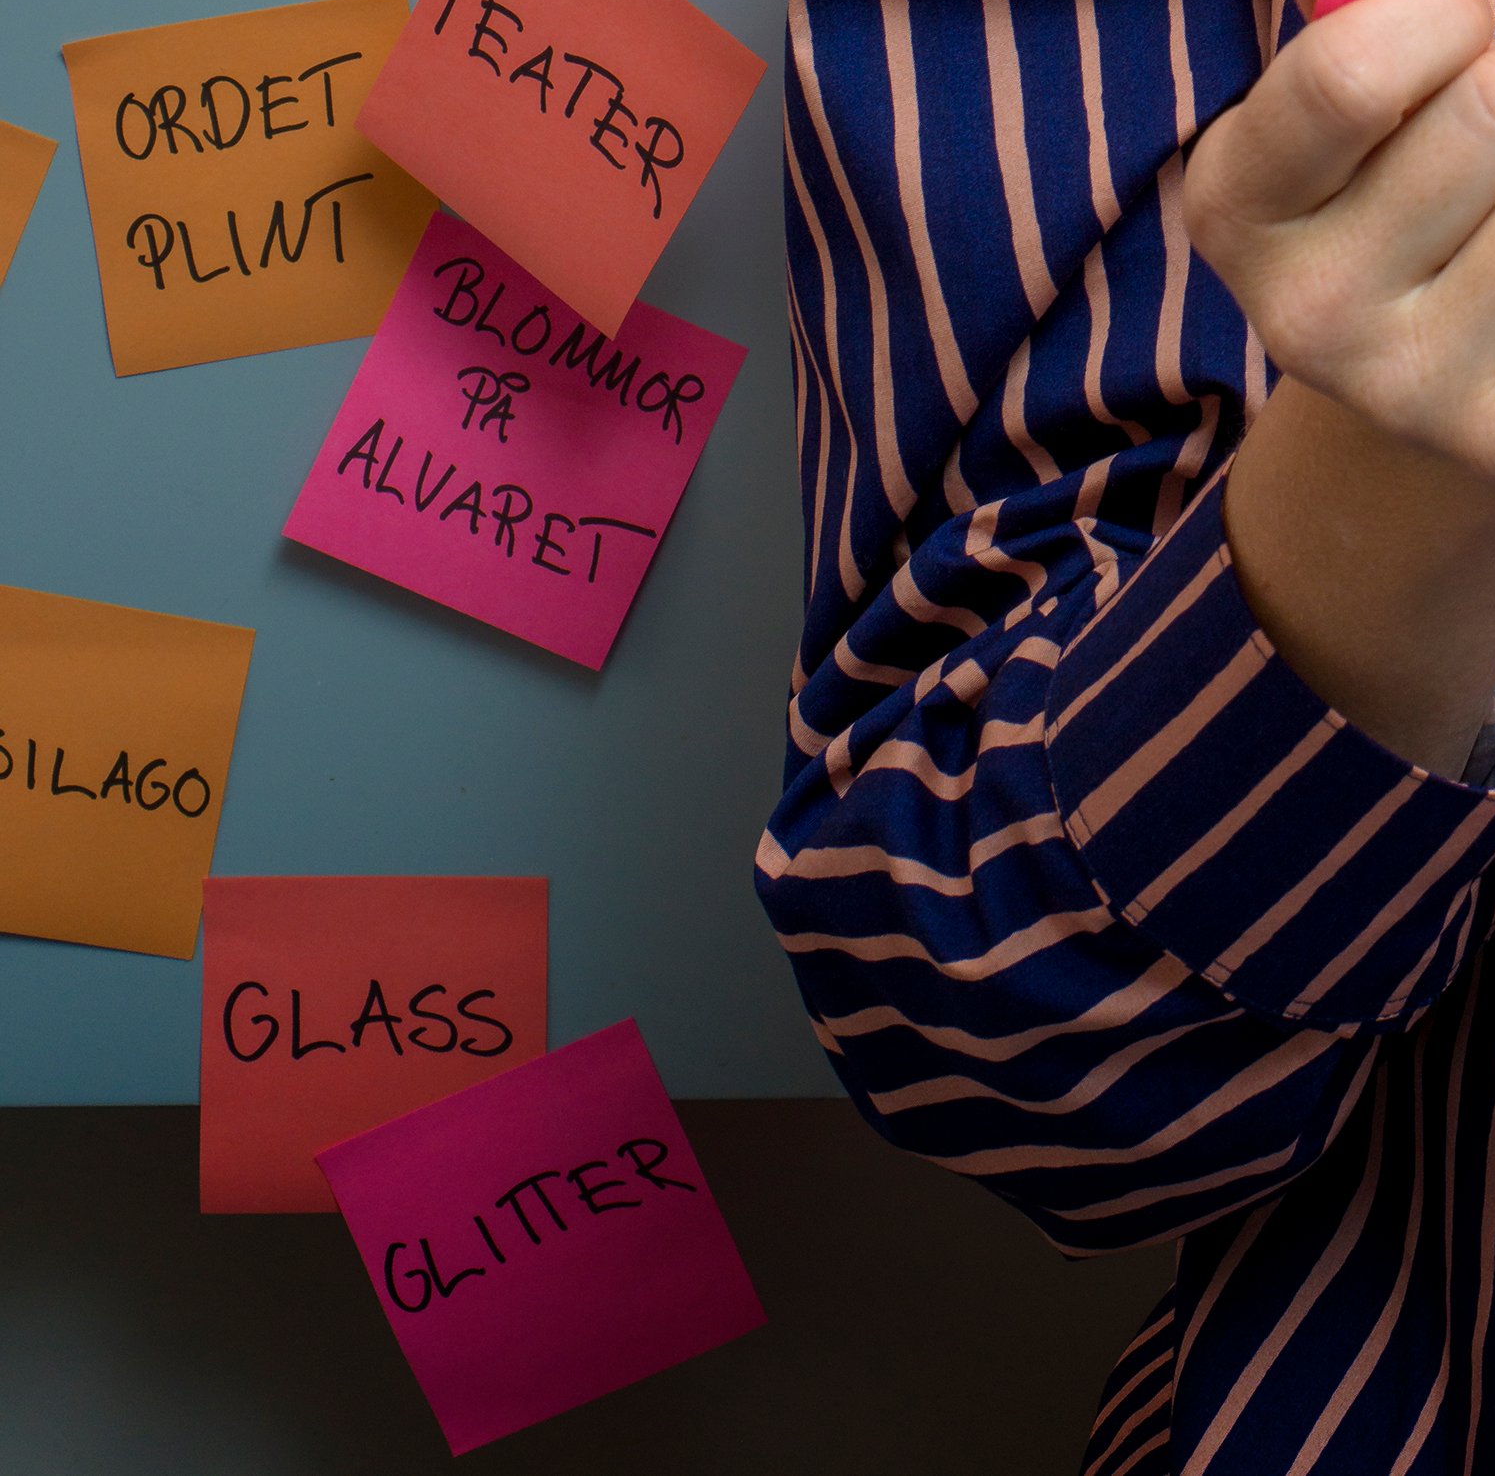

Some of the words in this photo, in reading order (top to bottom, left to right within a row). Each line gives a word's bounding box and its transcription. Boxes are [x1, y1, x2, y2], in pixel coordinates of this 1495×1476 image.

[115, 52, 362, 160] ORDET
[126, 173, 373, 290] PLINT
[433, 257, 704, 445] BLOMMOR
[457, 366, 531, 444] PÅ
[338, 418, 657, 584] ALVARET
[222, 979, 514, 1064] GLASS
[384, 1138, 697, 1313] GLITTER
